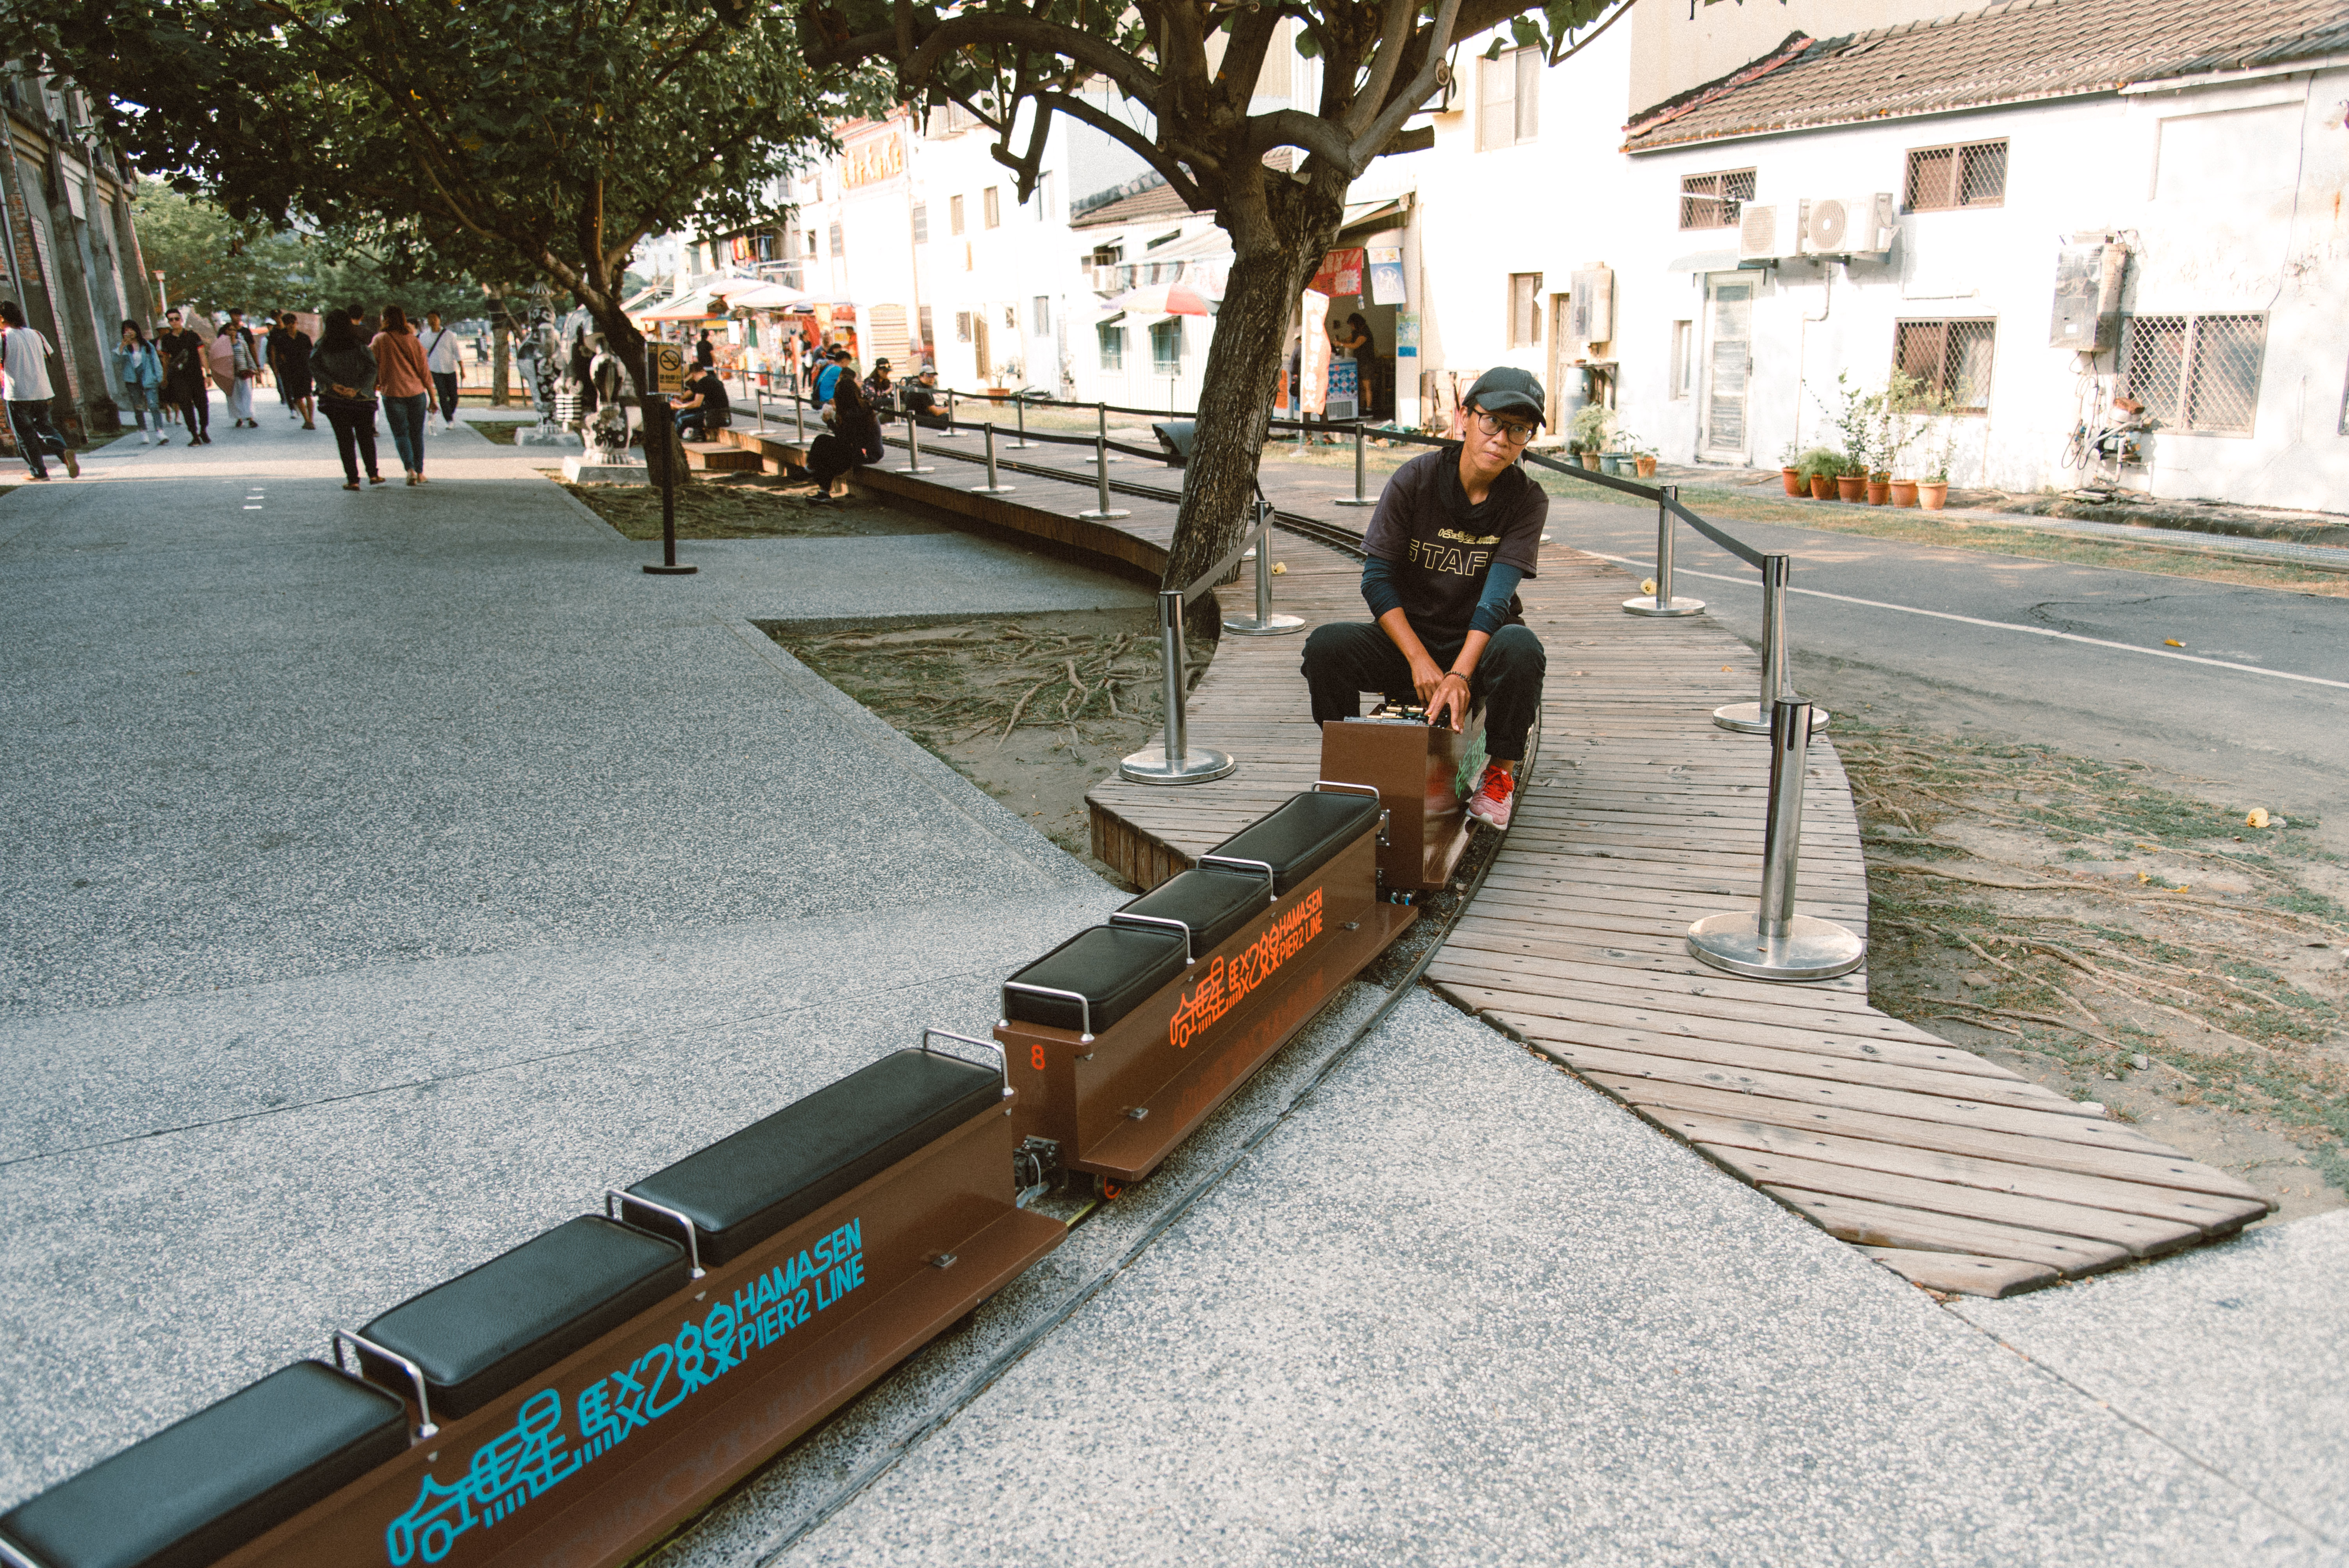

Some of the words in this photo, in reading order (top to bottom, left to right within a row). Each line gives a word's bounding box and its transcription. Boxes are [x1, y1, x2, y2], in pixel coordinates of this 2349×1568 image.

[1409, 538, 1495, 576] STAF
[1279, 886, 1322, 941] HAMASEN
[1280, 926, 1304, 965] PIER2
[1305, 910, 1322, 943] LINE
[1031, 1044, 1046, 1070] 8
[734, 1217, 862, 1324] HAMASEN
[738, 1288, 811, 1361] PIER2
[814, 1252, 865, 1311] LINE
